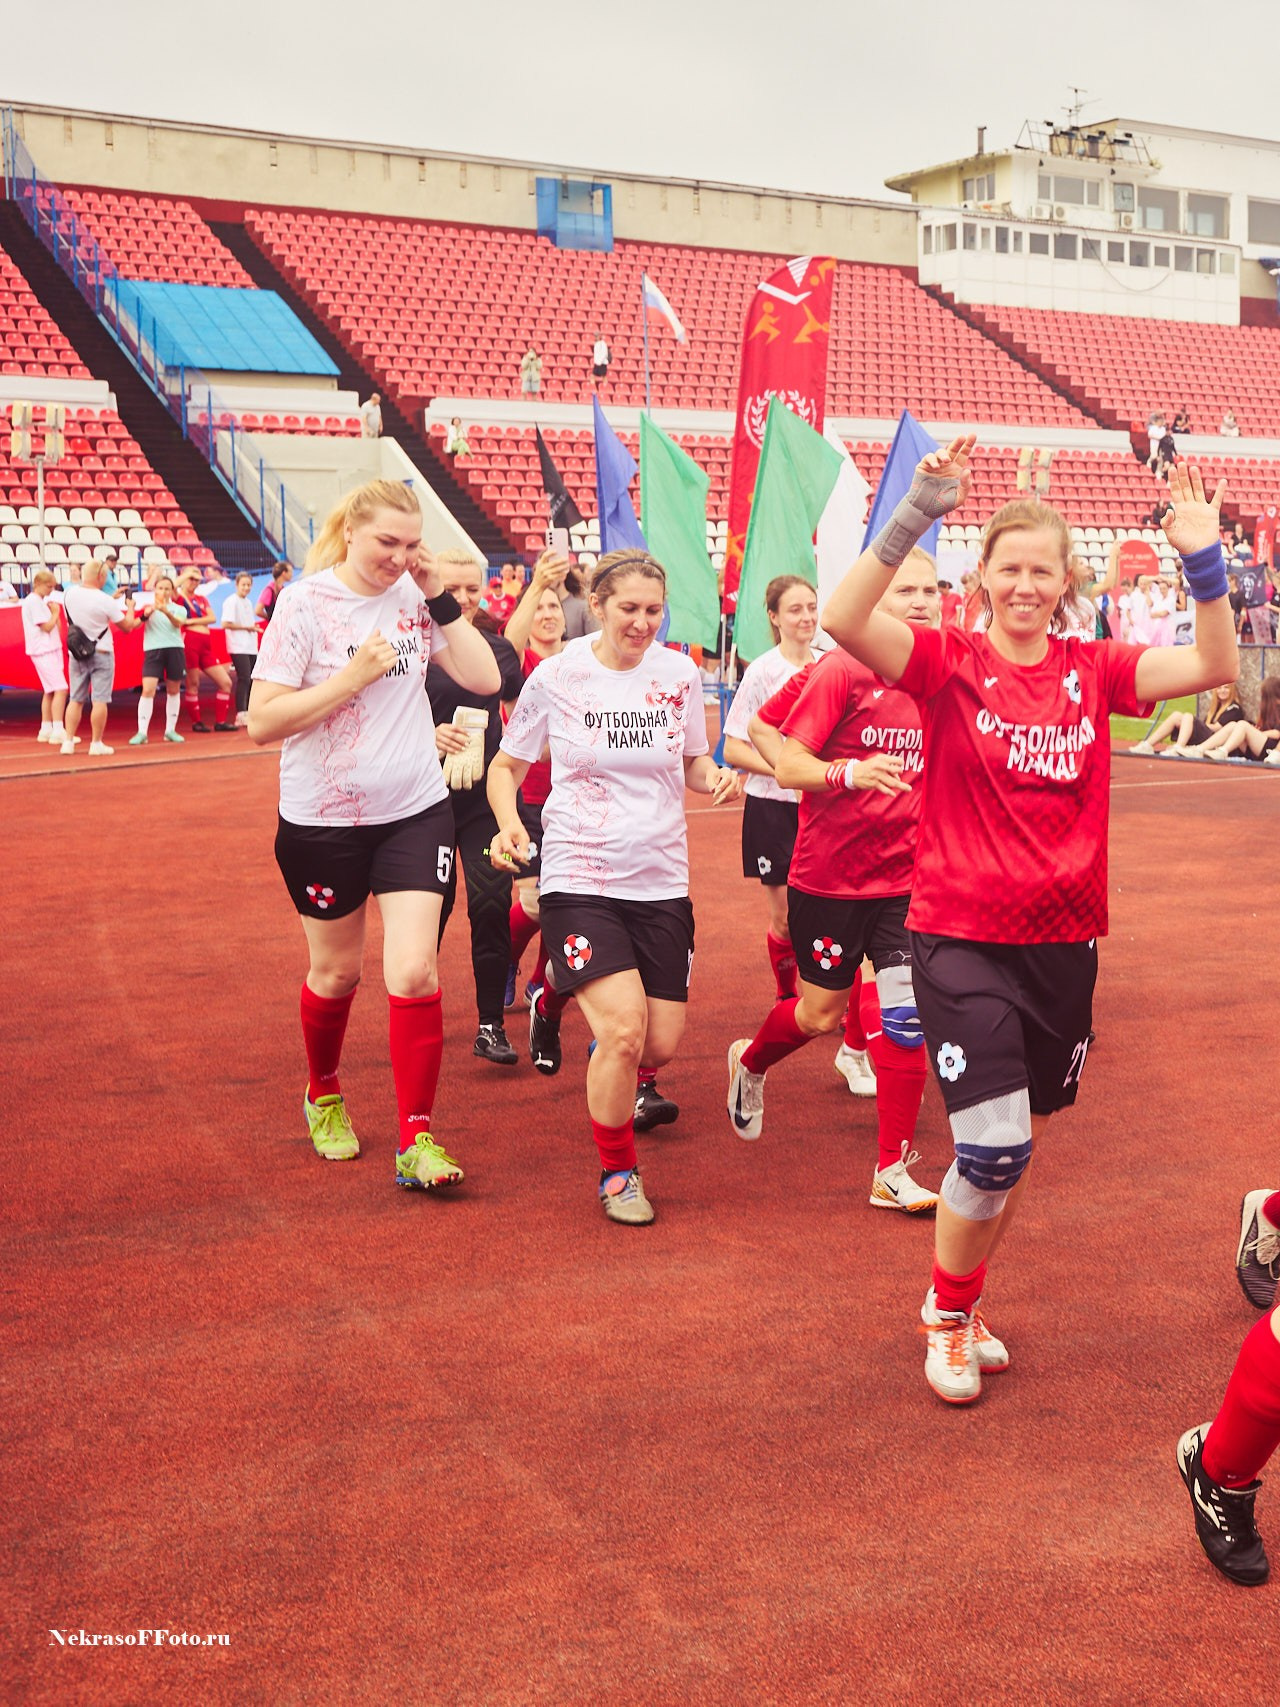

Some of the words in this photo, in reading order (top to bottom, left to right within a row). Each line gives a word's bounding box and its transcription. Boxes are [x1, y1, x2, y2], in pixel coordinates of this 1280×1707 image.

[584, 710, 668, 729] ФУТБОЛЬНАЯ
[607, 729, 654, 749] МАМА!
[860, 725, 923, 749] ФУТБОЛ
